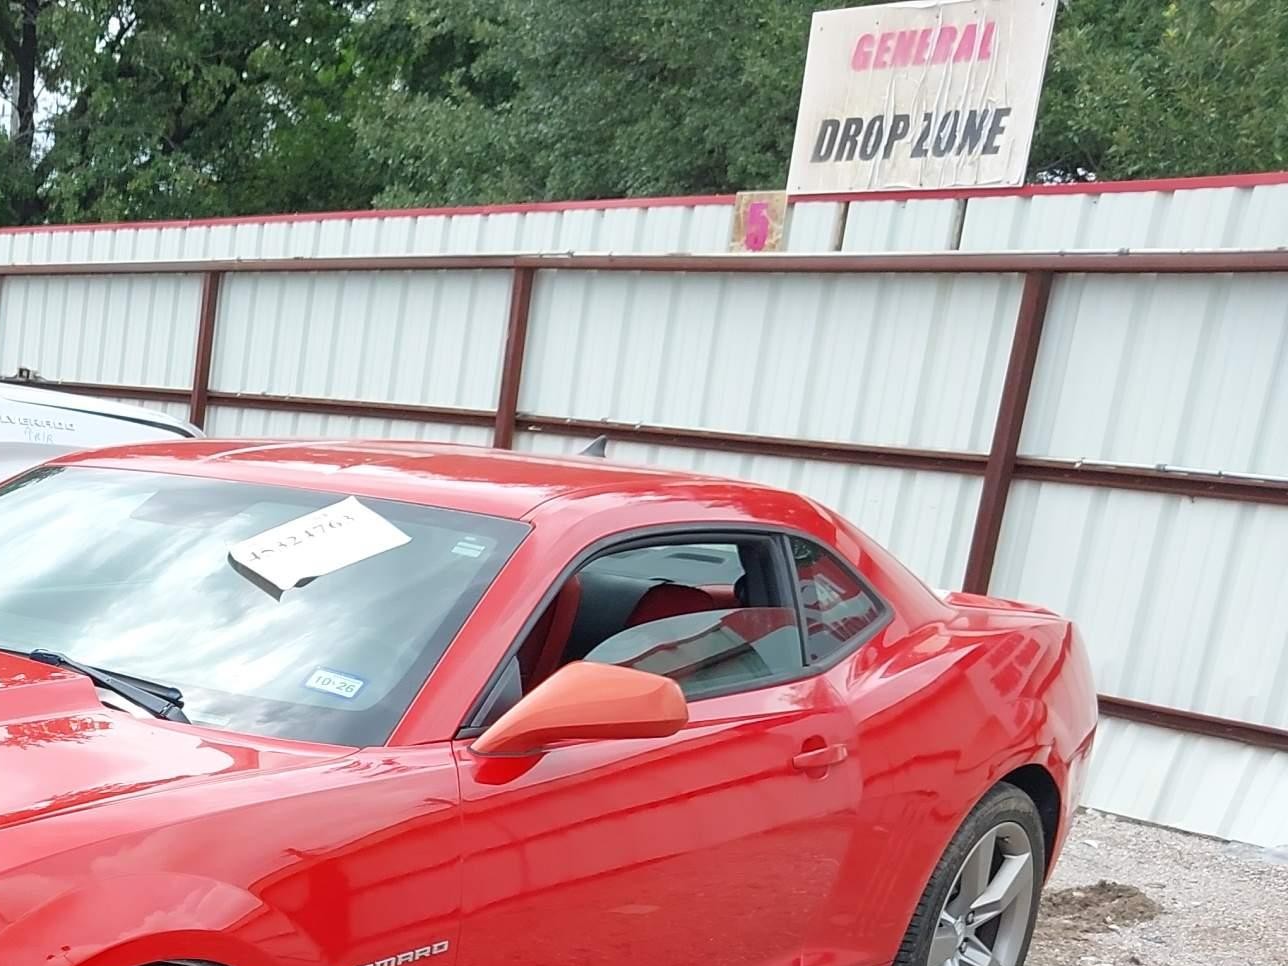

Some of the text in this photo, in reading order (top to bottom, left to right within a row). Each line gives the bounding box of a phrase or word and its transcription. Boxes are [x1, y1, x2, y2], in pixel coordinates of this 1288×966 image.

[850, 21, 996, 72] GENERAL
[809, 107, 1012, 163] DROP ZONE
